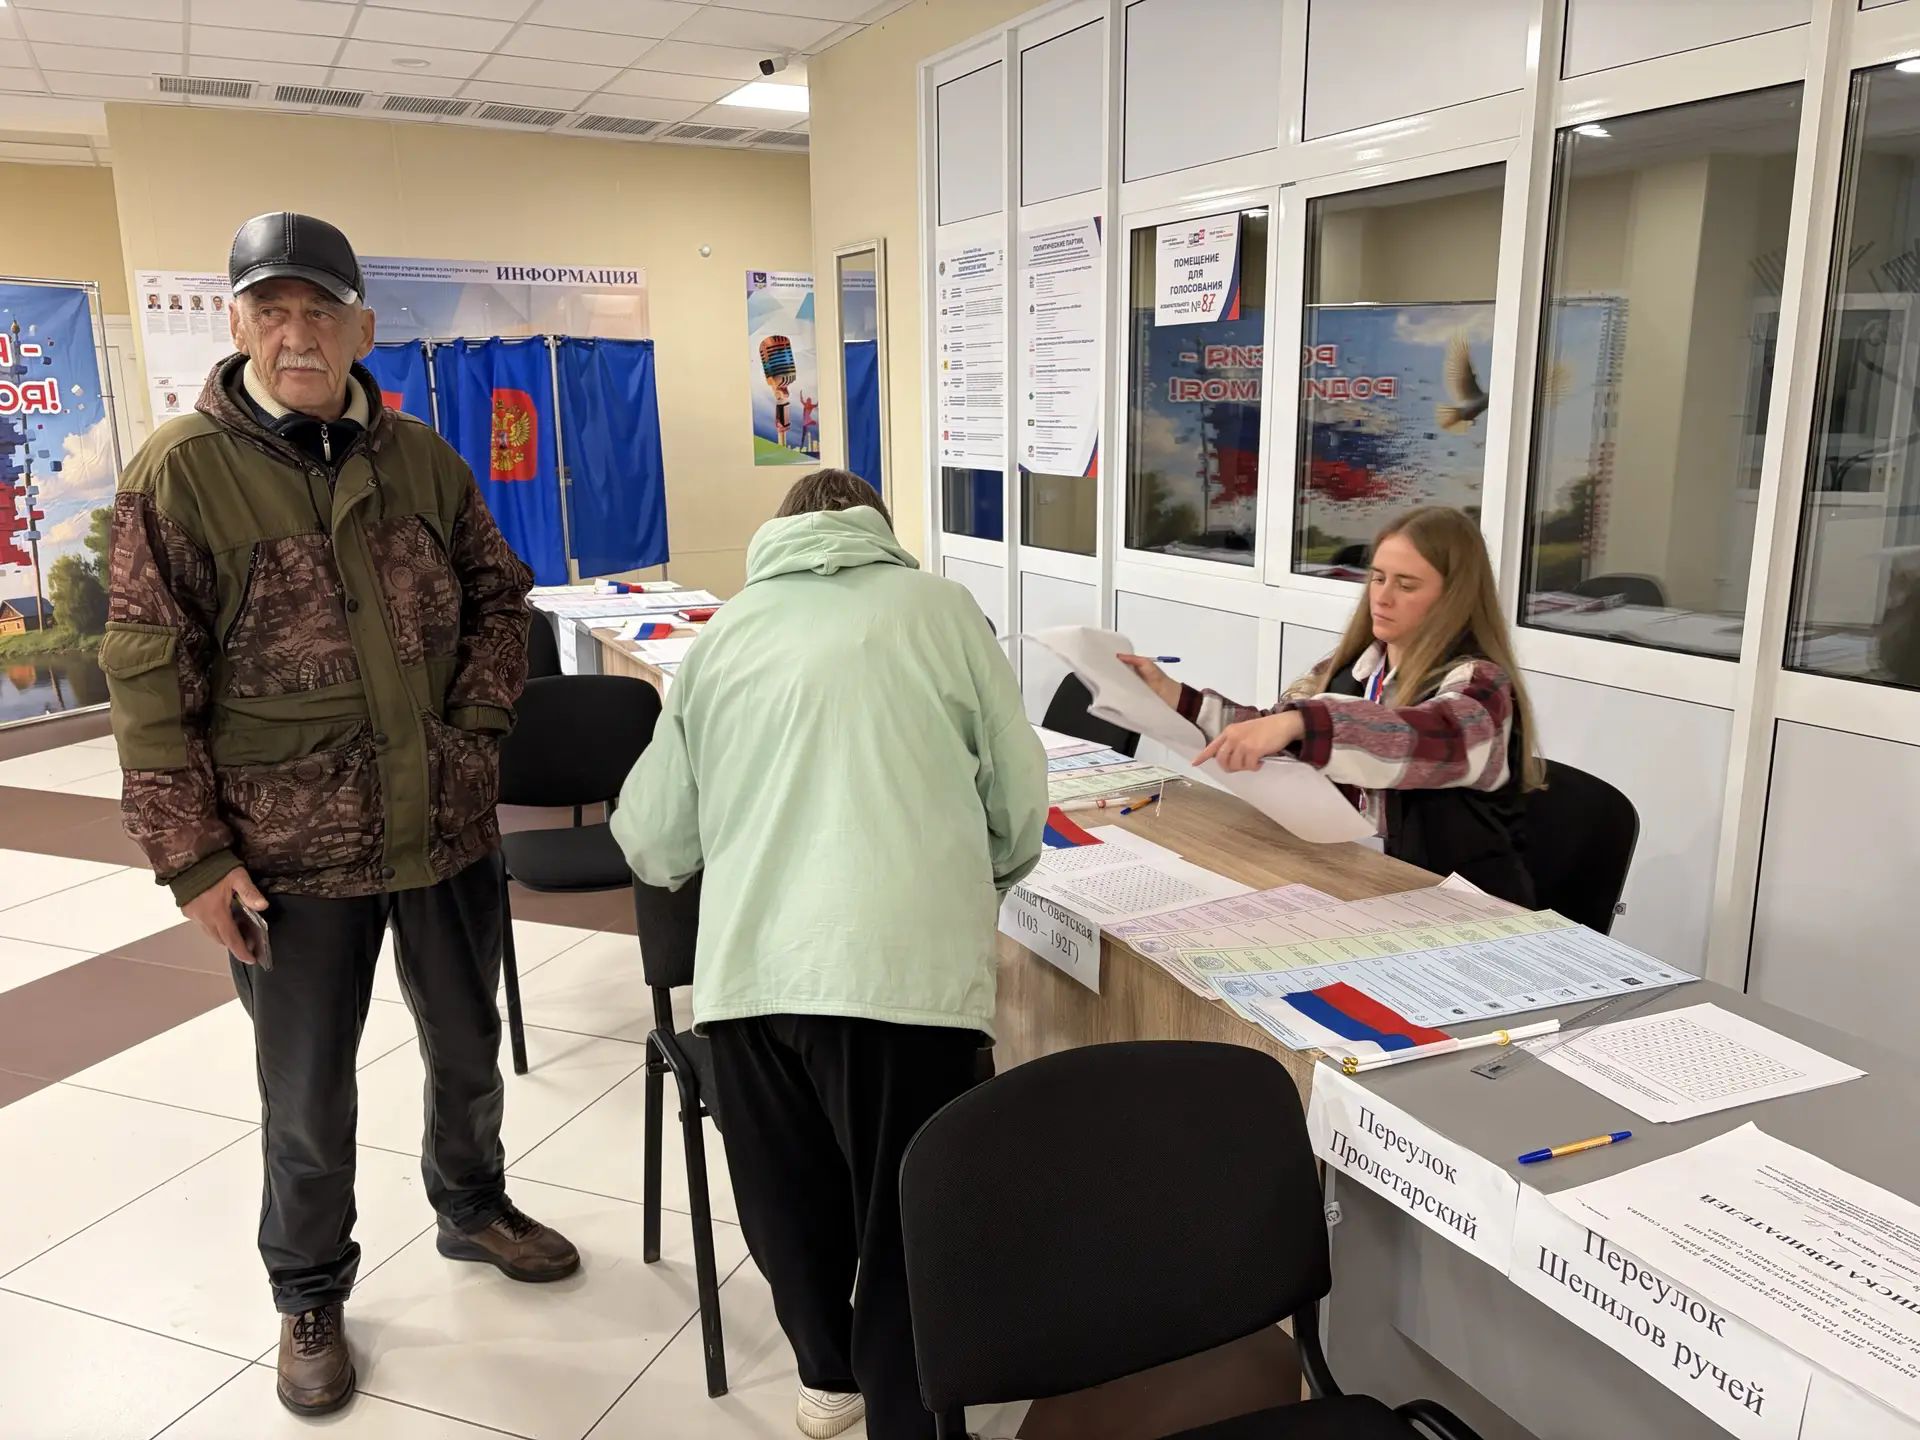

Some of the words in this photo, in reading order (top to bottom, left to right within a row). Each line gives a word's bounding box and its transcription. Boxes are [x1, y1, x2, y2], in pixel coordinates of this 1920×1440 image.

[1174, 253, 1219, 267] ПОМЕЩЕНИЕ
[1188, 269, 1203, 280] ДЛЯ
[496, 266, 638, 285] ИНФОРМАЦИЯ
[1170, 281, 1223, 295] ГОЛОСОВАНИЯ
[1191, 300, 1201, 312] №
[1201, 294, 1216, 312] 87
[1009, 885, 1037, 907] лица
[1040, 896, 1093, 942] Советская
[1017, 908, 1038, 934] (103
[1358, 1106, 1458, 1185] Переулок
[1329, 1129, 1479, 1241] Пролетарский
[1627, 1206, 1660, 1227] СОЗЫВА
[1661, 1226, 1708, 1253] ДЕВЯТОГО
[1684, 1223, 1732, 1250] СОБРАНИЯ
[1699, 1194, 1845, 1271] ИЗБИРАТЕЛЕЙ
[1708, 1228, 1743, 1249] СОЗЫВА
[1671, 1239, 1701, 1257] ДУМЫ
[1745, 1248, 1797, 1278] ВОСЬМОГО
[1584, 1226, 1726, 1338] Переулок
[1702, 1257, 1797, 1312] ГОСУДАРСТВЕННОЙ
[1710, 1253, 1766, 1286] ФЕДЕРАЦИИ
[1736, 1250, 1837, 1308] ЗАКОНОДАТЕЛЬНОГО
[1770, 1287, 1839, 1328] РОССИЙСКОЙ
[1801, 1279, 1848, 1306] ОБЛАСТИ
[1537, 1245, 1666, 1348] Шепилов
[1672, 1341, 1765, 1417] ручей
[1801, 1313, 1865, 1349] ДЕПУТАТОВ
[1841, 1309, 1906, 1346] ДЕПУТАТОВ
[1843, 1329, 1902, 1362] СОБРАНИЯ
[1868, 1351, 1917, 1379] ВЫБОРЫ
